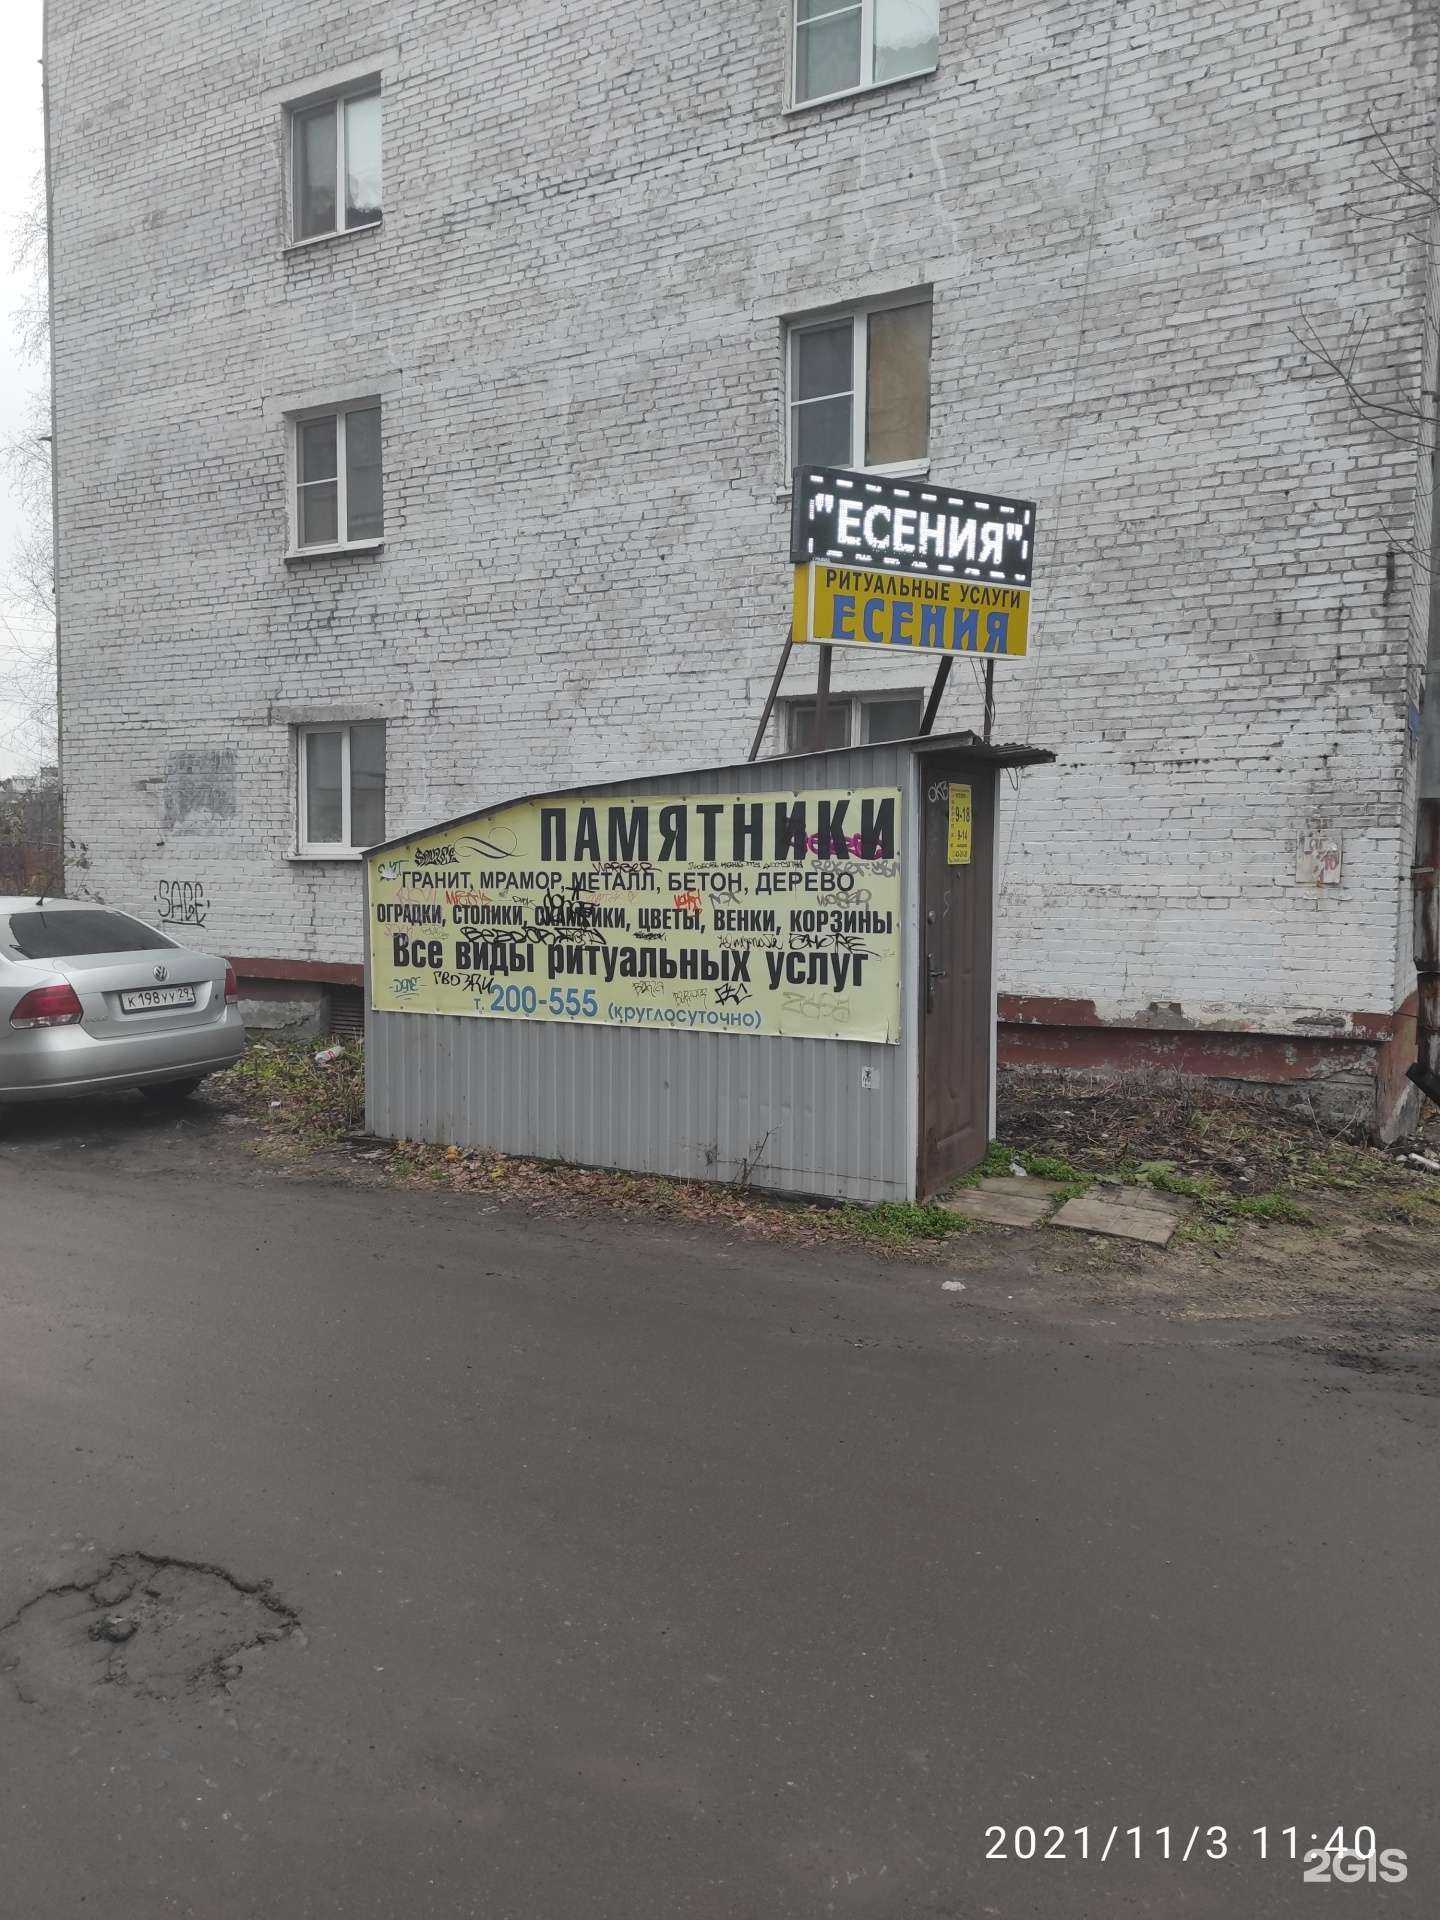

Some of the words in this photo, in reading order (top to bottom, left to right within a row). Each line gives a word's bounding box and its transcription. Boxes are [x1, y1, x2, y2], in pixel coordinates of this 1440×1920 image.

[814, 493, 1023, 564] "ЕСЕНИЯ"
[826, 569, 950, 601] РИТУАЛЬНЫЕ
[960, 585, 1022, 610] УСЛУГИ
[832, 594, 1009, 655] ЕСЕНИЯ
[541, 797, 895, 862] ПАМЯТНИКИ
[402, 871, 473, 892] ГРАНИТ,
[480, 871, 565, 893] МРАМОР,
[572, 871, 661, 895] МЕТАЛЛ,
[668, 871, 749, 895] БЕТОН,
[755, 871, 855, 895] ДЕРЕВО
[377, 903, 446, 927] ОГРАДКИ,
[452, 904, 527, 927] СТОЛИКИ,
[638, 908, 705, 934] ЦВЕТЫ,
[714, 909, 781, 936] ВЕНКИ,
[790, 910, 893, 934] КОРЗИНЫ
[393, 932, 443, 969] Все
[456, 941, 535, 977] виды
[548, 943, 751, 983] ритуальных
[766, 951, 869, 993] услуг
[490, 984, 598, 1018] 200-555
[608, 1002, 762, 1029] (круглосуточно)
